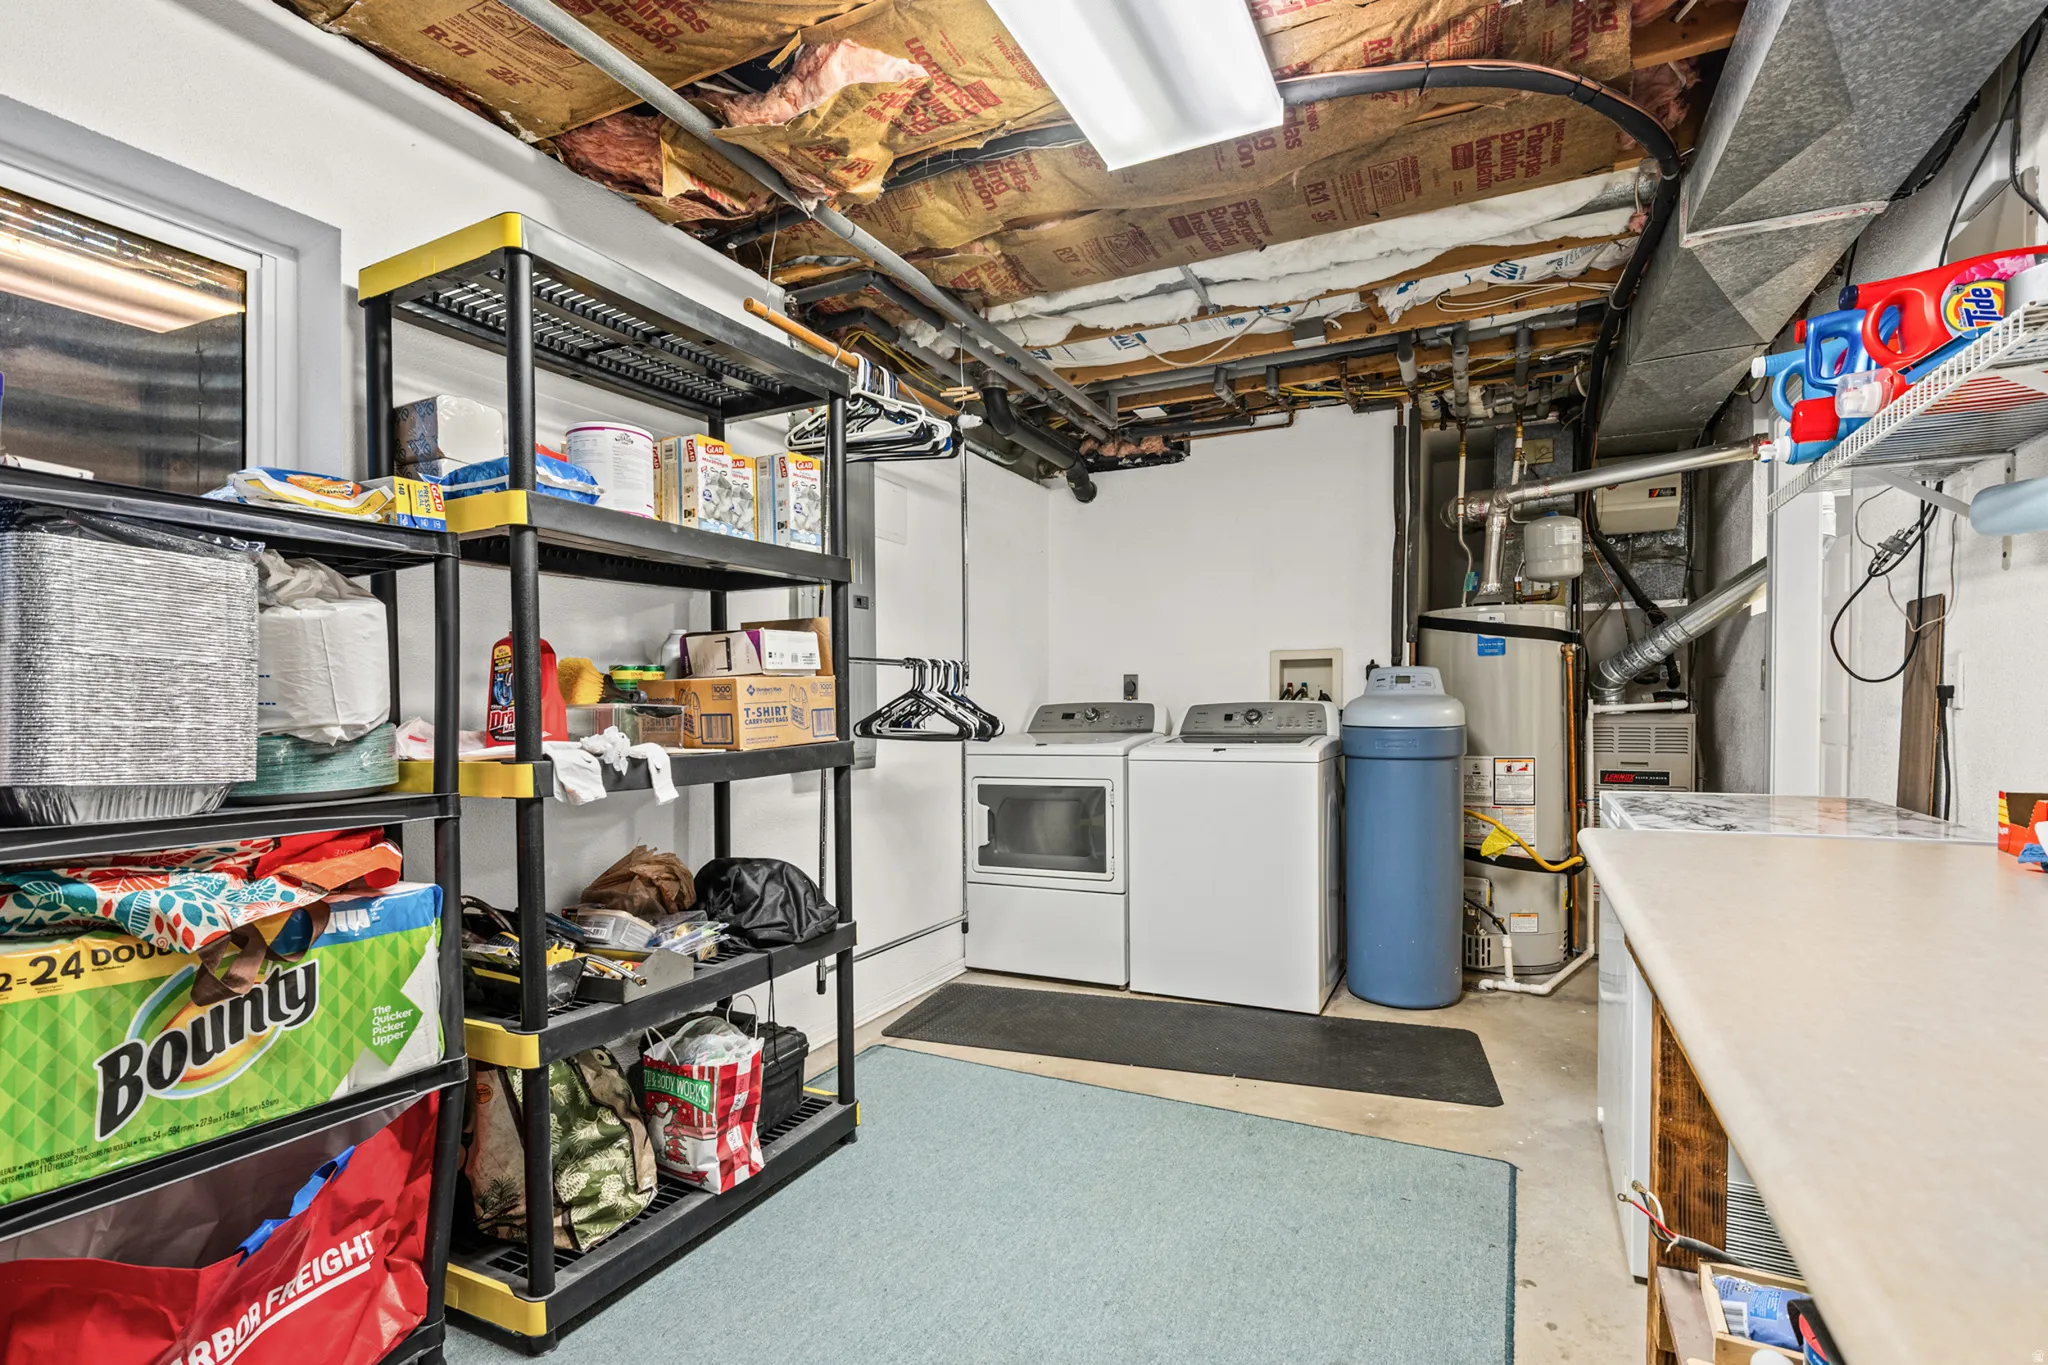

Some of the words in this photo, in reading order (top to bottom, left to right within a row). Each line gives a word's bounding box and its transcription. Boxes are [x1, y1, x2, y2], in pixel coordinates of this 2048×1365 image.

[1494, 129, 1525, 182] Building
[1524, 121, 1553, 179] Fiberglas
[1475, 134, 1499, 192] Insulation
[1207, 205, 1240, 247] Building
[1964, 288, 2003, 327] Tide
[685, 439, 696, 462] GLAD
[706, 444, 724, 455] GLAD
[779, 457, 788, 478] GLAD
[796, 461, 813, 470] GLAD
[398, 483, 406, 496] 140
[417, 490, 425, 507] SEAL
[430, 484, 445, 512] GLAD
[744, 706, 788, 718] T-SHIRT
[744, 717, 775, 726] CARRY-OUT
[1604, 773, 1635, 781] LENNOX
[29, 951, 85, 986] 24
[372, 1005, 391, 1016] The
[372, 1009, 413, 1026] Quicker
[372, 1021, 406, 1036] Picker
[372, 1031, 405, 1046] Upper
[98, 961, 319, 1139] Bounty
[656, 1074, 676, 1091] BODY
[676, 1078, 709, 1107] WORKS
[151, 1130, 161, 1140] 54
[264, 1230, 376, 1316] FREIGHT
